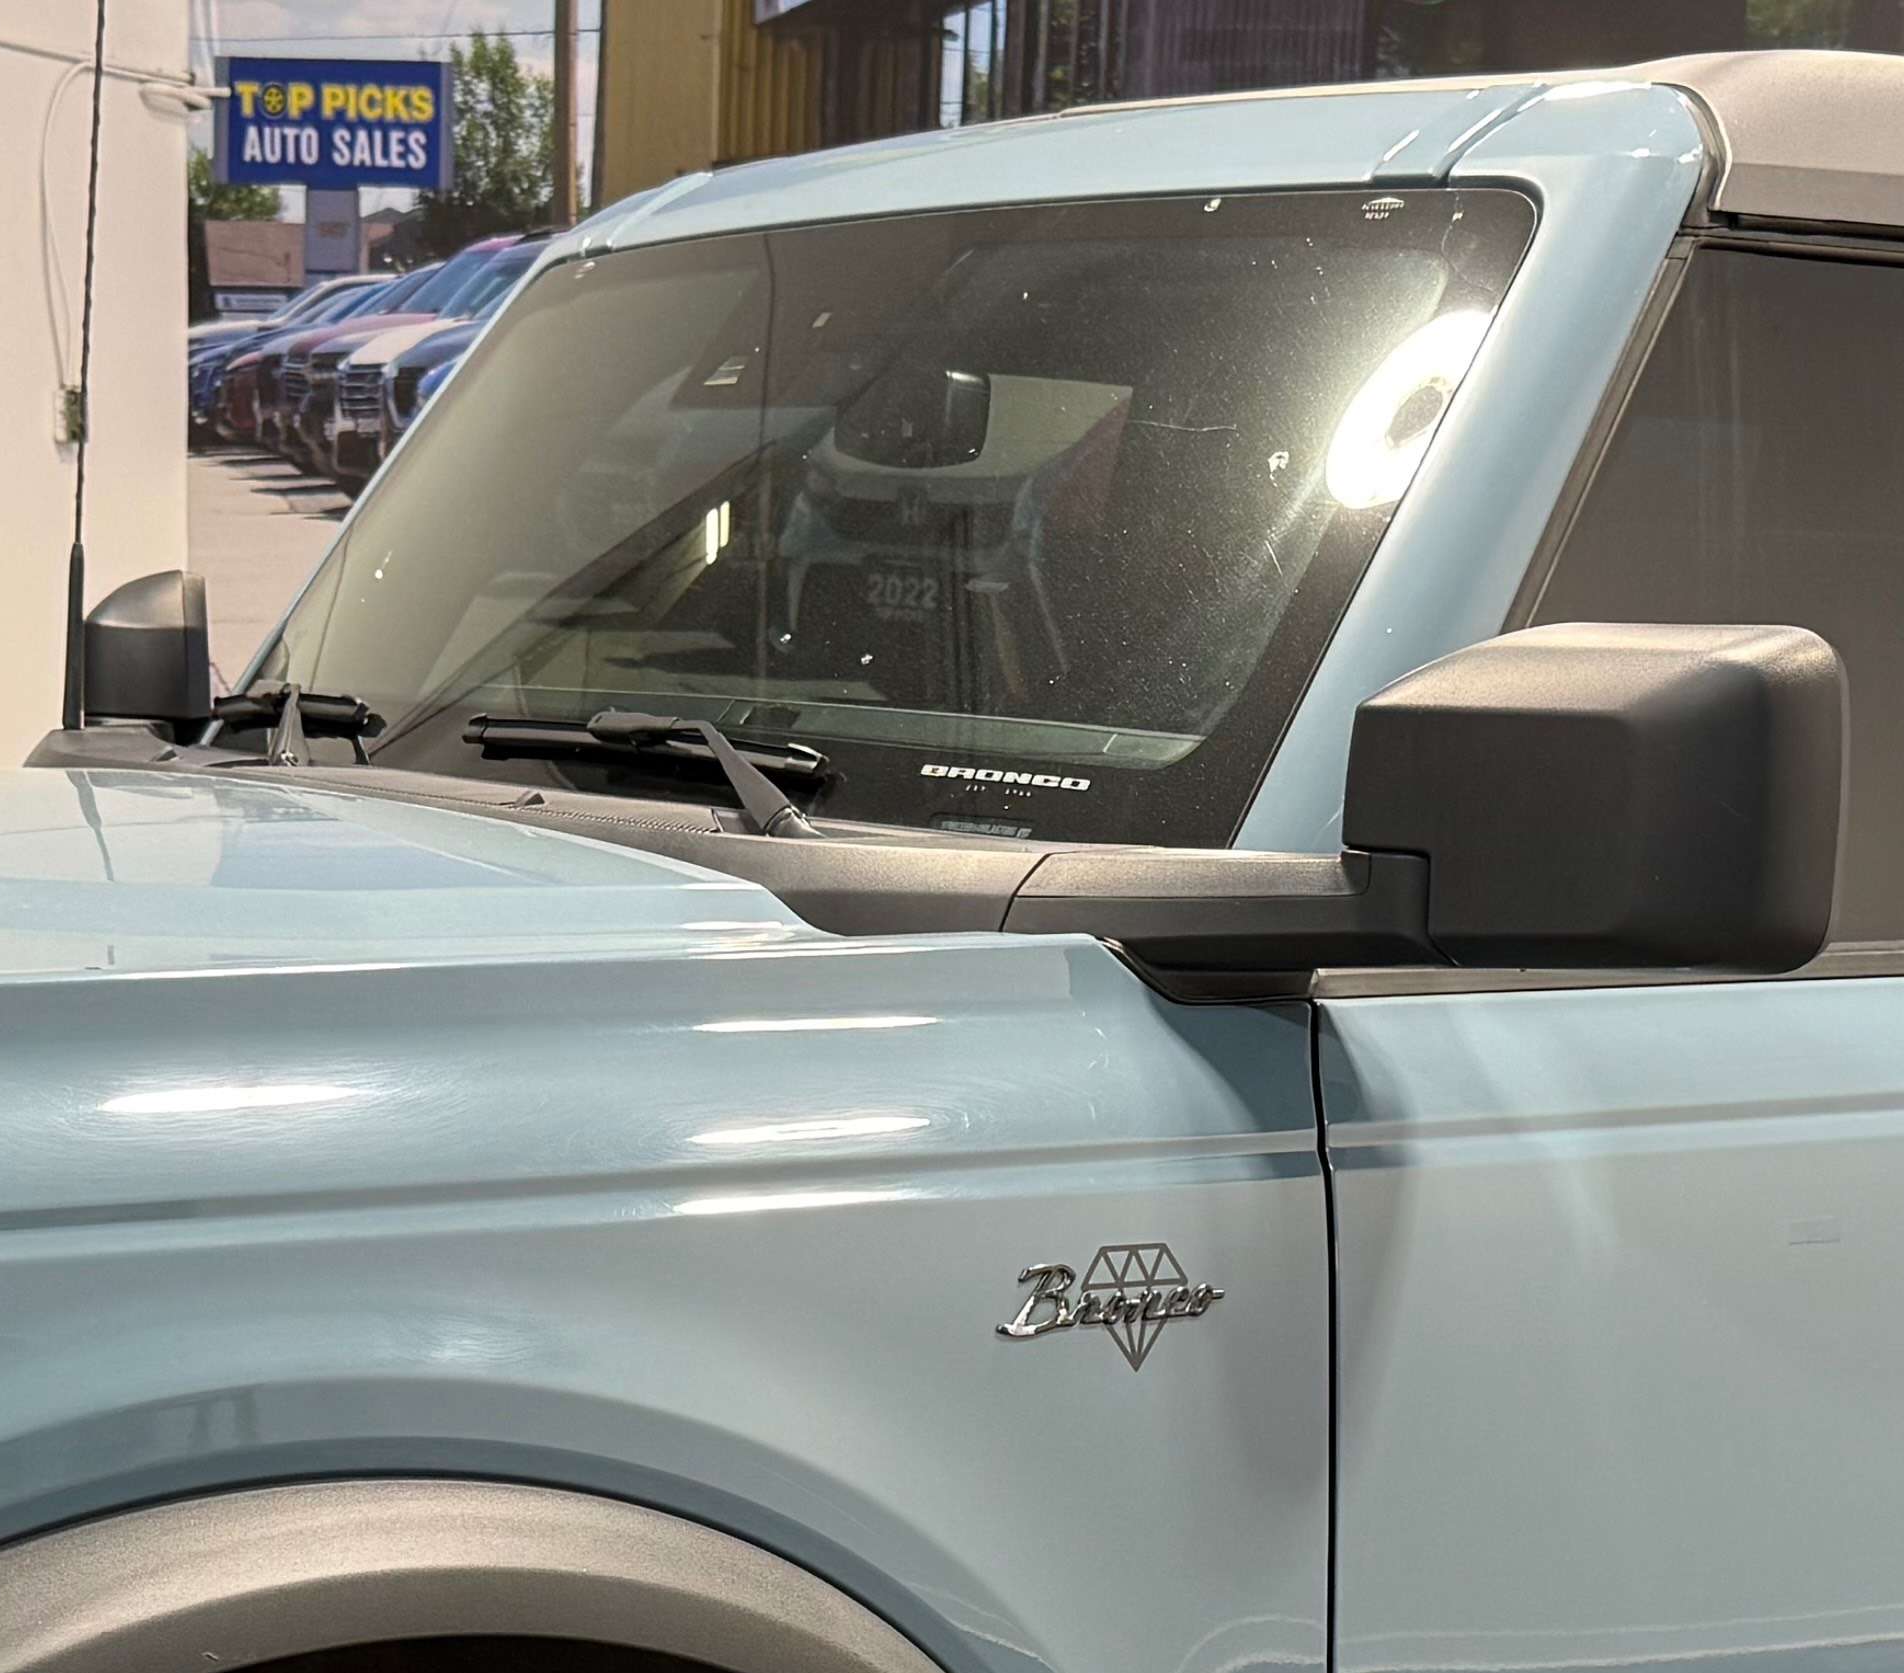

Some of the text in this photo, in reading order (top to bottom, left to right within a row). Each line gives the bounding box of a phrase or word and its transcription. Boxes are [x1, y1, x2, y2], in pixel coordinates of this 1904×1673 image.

[234, 81, 434, 123] TOP PICKS
[243, 125, 427, 169] AUTO SALES
[920, 764, 1091, 791] BRONCO
[995, 1263, 1225, 1338] Bronco
